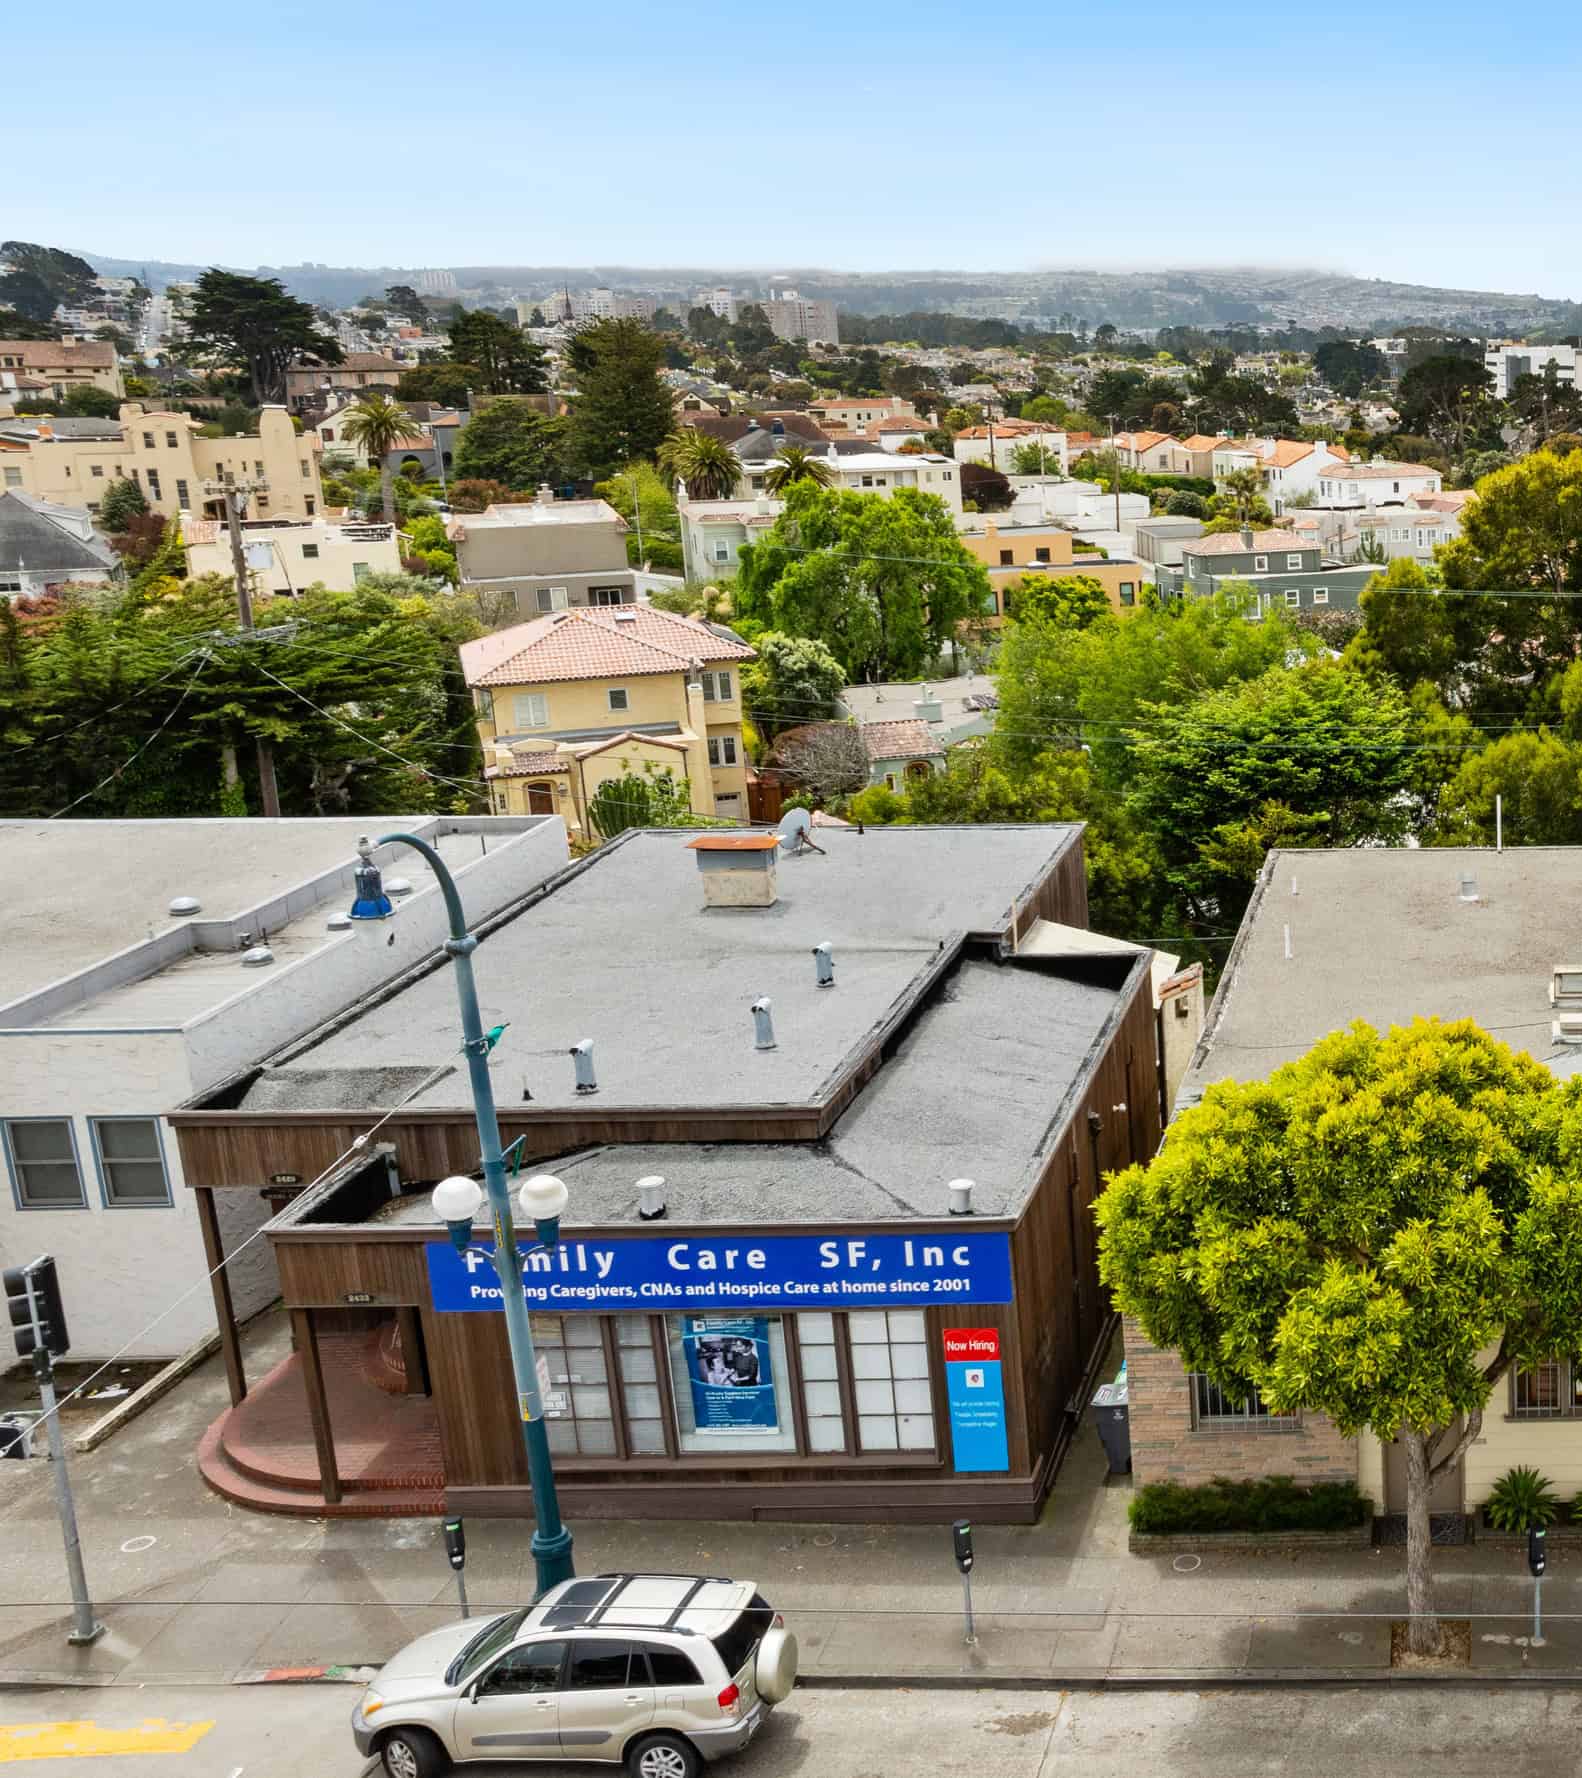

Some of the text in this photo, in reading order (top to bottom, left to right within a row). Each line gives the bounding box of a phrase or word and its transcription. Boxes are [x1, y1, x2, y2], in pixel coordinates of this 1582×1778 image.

[466, 1240, 971, 1278] Fmily Care SF, Inc
[470, 1278, 971, 1301] Proving Caregivers, CNAs and Hospice Care at home since 2001
[946, 1339, 996, 1353] Now Hiring
